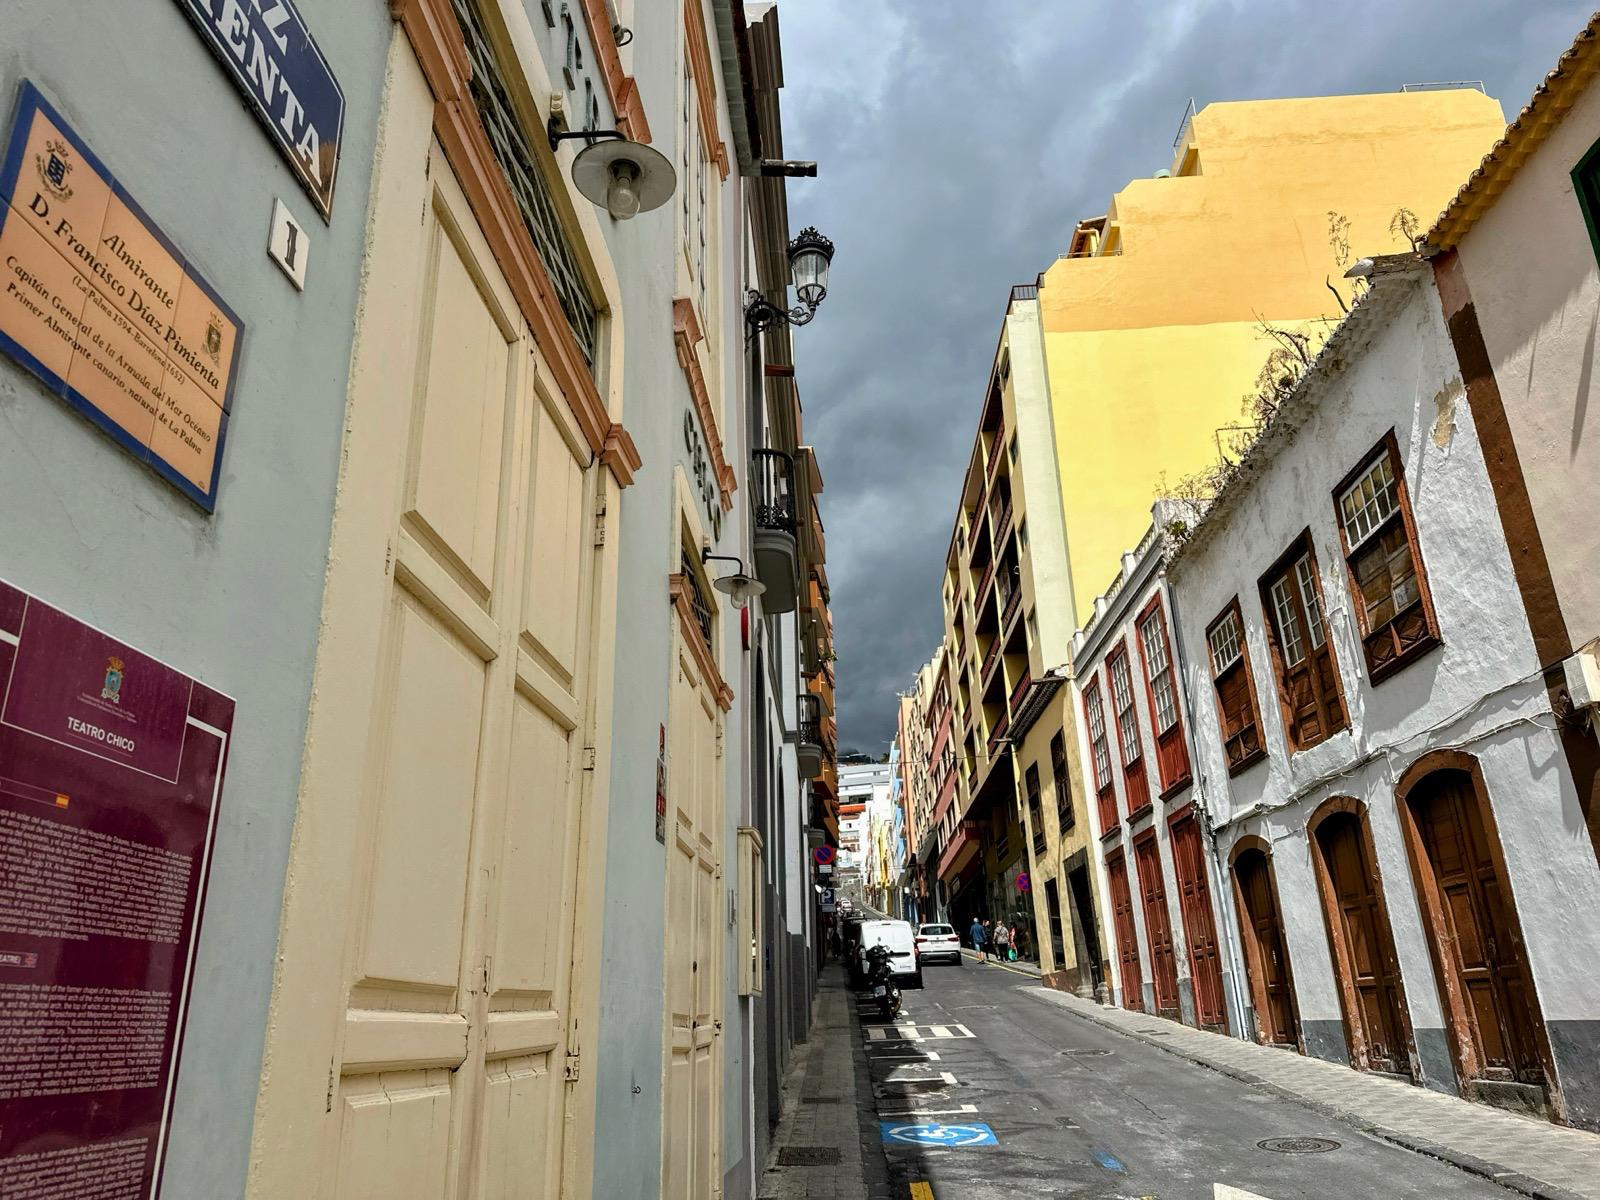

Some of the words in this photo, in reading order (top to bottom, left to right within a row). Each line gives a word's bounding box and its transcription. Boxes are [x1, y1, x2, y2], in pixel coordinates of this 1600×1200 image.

[201, 0, 323, 187] ENTA
[6, 256, 49, 300] Capitán
[52, 296, 93, 337] General
[92, 334, 104, 348] de
[105, 344, 116, 358] la
[116, 355, 151, 390] Armada
[152, 386, 166, 402] del
[165, 396, 183, 416] Mar
[183, 413, 211, 442] Océano
[28, 192, 50, 226] D.
[54, 218, 125, 297] Francisco
[128, 289, 163, 336] Díaz
[163, 325, 220, 390] Pimienta
[88, 290, 113, 317] Palma
[102, 235, 174, 309] Almirante
[7, 282, 44, 318] Primer
[44, 316, 92, 360] Almirante
[92, 357, 127, 393] canario,
[128, 387, 160, 417] natural
[158, 413, 168, 425] de
[168, 421, 179, 435] La
[179, 429, 202, 455] Palma
[68, 716, 105, 741] TEATRO
[106, 732, 135, 752] CHICO
